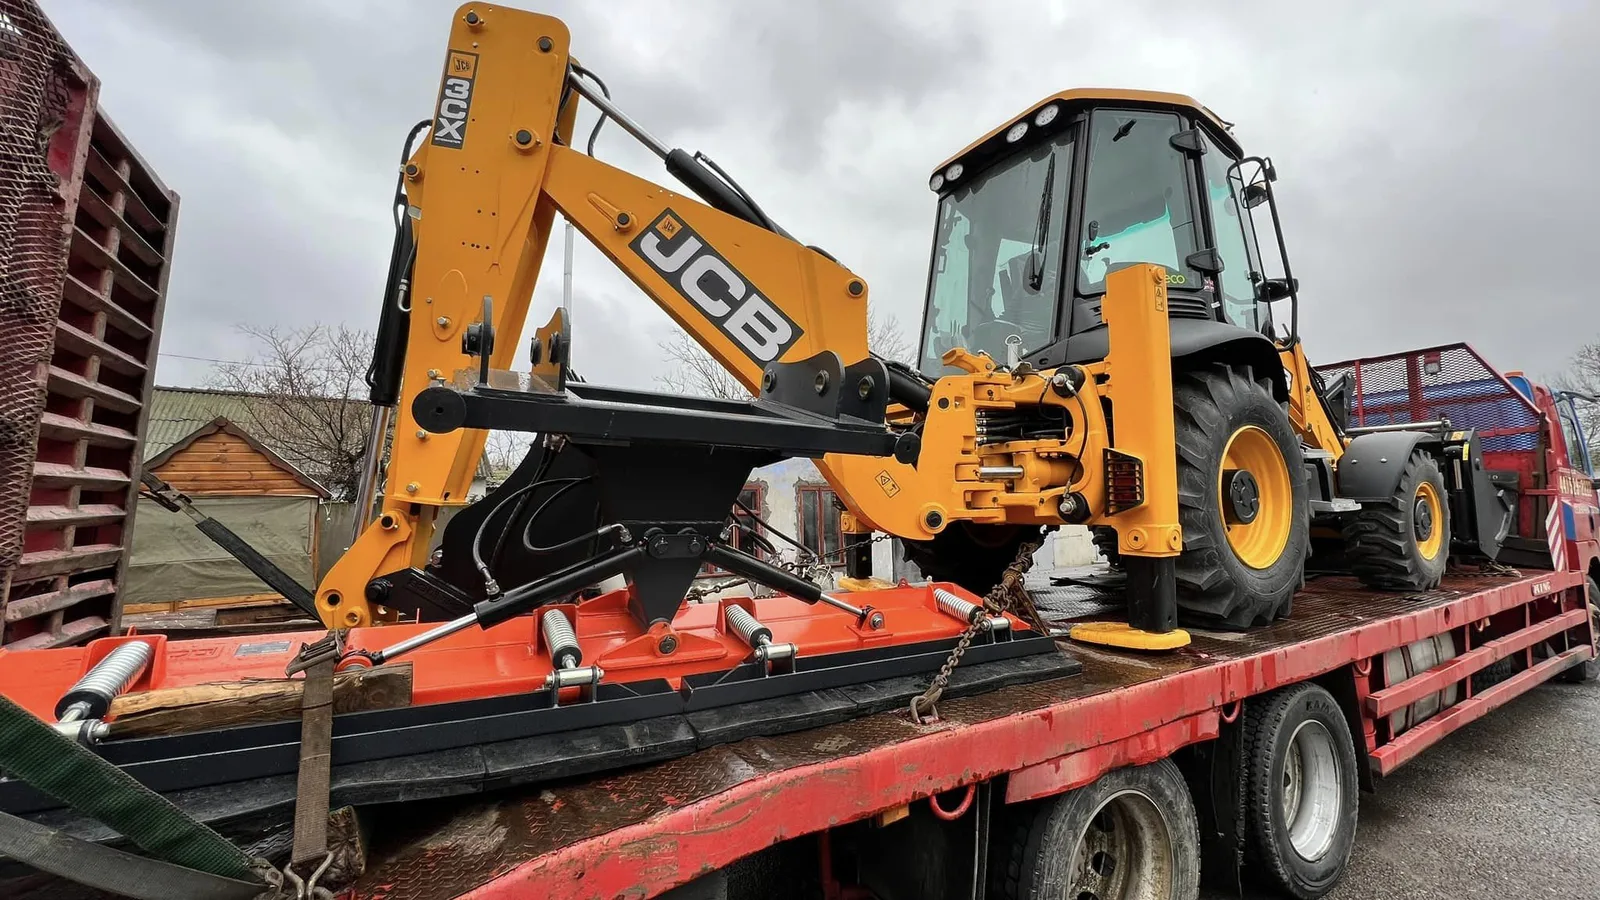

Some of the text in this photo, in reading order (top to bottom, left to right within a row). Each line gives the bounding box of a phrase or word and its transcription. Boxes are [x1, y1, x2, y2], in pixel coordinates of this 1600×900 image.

[435, 78, 470, 140] 3CX
[640, 231, 793, 361] JCB
[1165, 274, 1185, 283] eco
